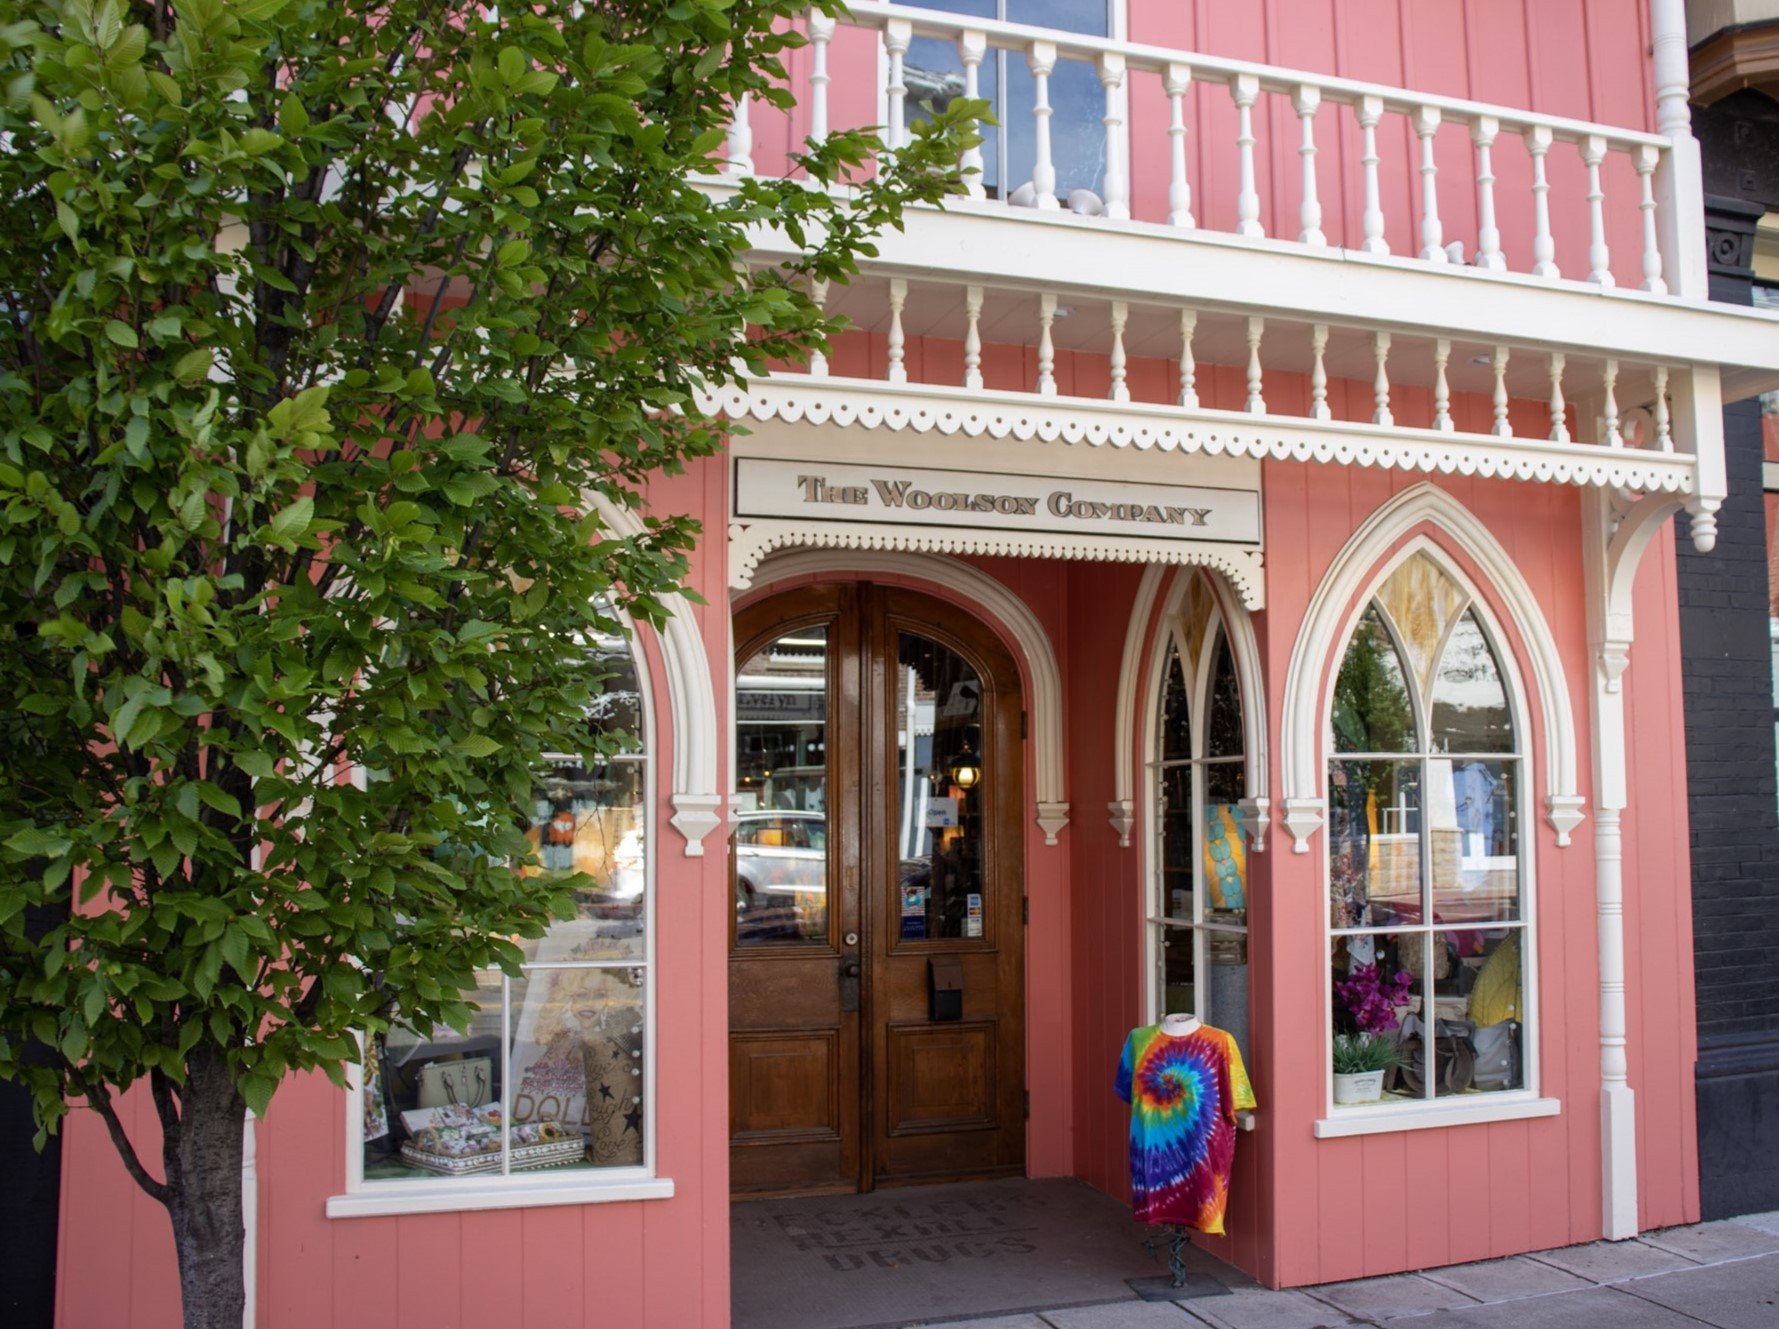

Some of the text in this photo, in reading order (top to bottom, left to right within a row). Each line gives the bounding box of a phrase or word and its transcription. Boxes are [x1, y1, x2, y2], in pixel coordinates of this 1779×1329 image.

[798, 475, 1213, 526] THE WOOLSON COMPANY
